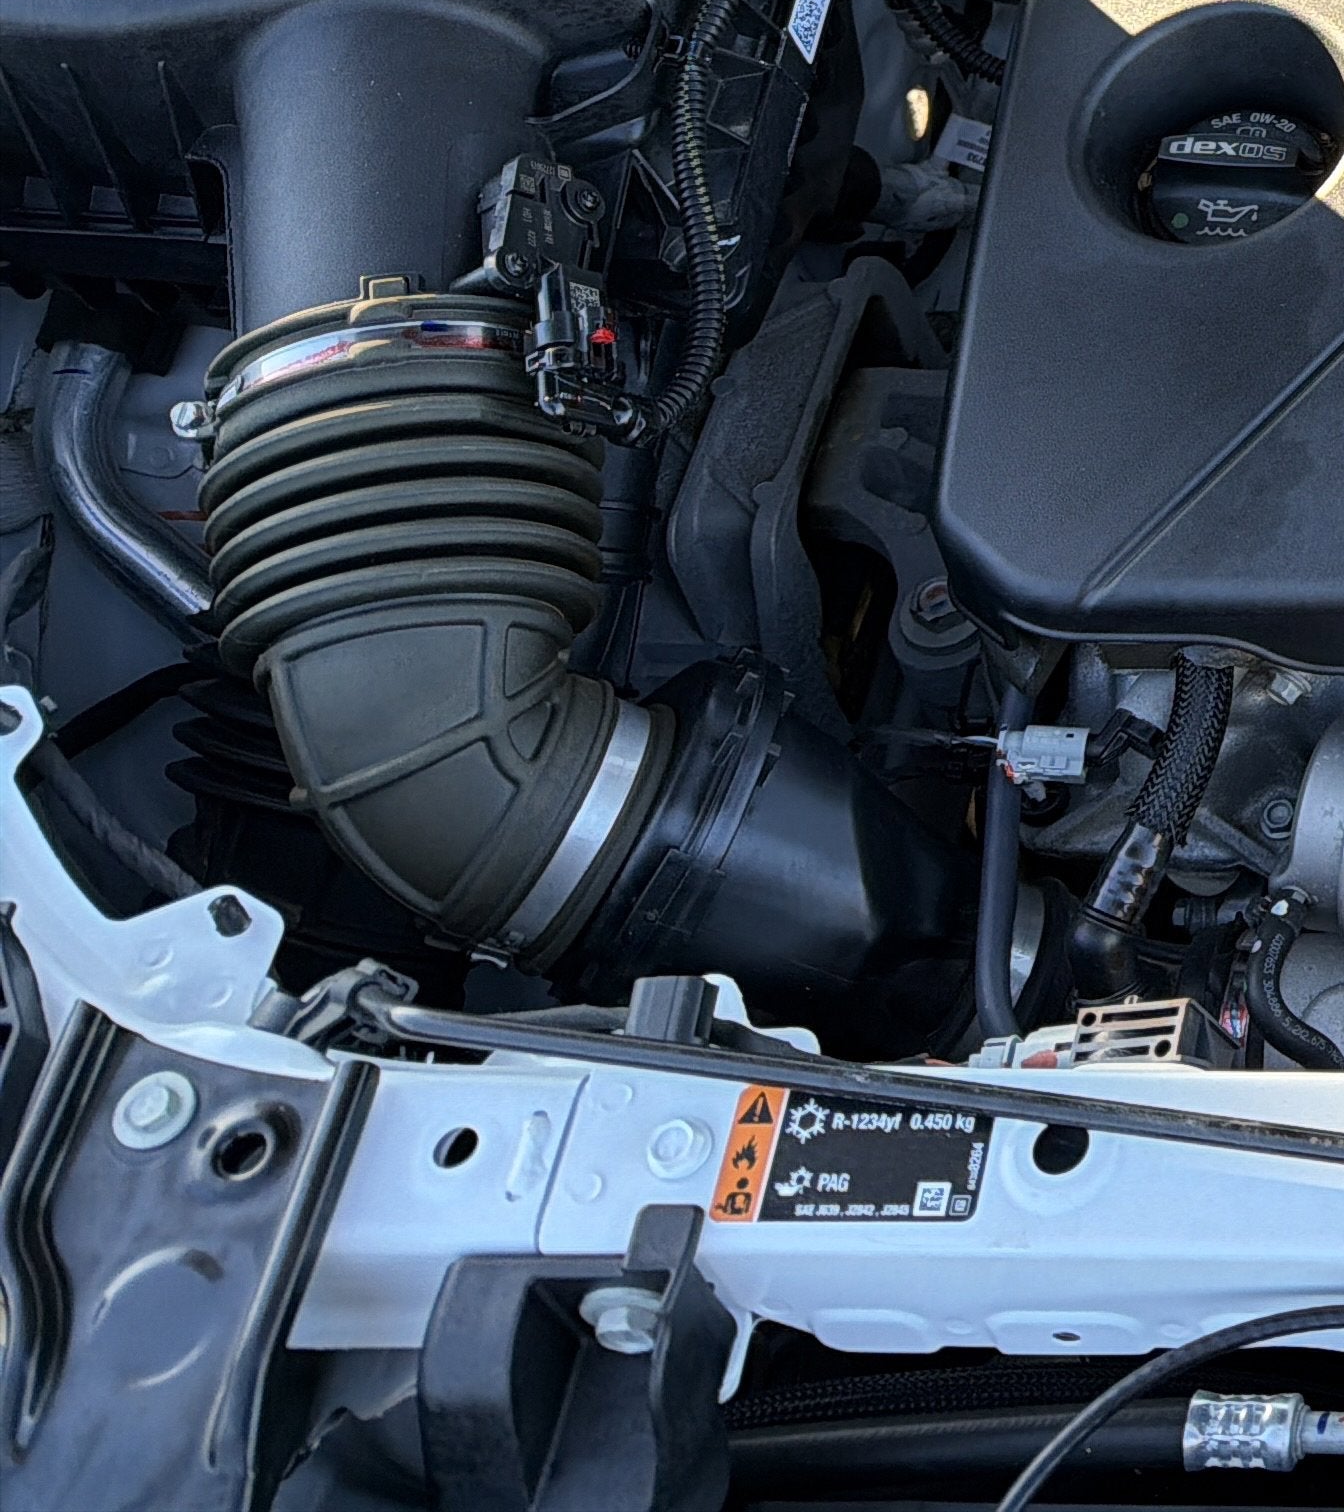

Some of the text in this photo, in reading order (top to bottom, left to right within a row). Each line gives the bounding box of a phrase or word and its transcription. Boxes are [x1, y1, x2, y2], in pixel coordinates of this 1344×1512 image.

[1210, 112, 1297, 133] SAE 0W-20
[1168, 136, 1288, 162] dexos
[831, 1112, 977, 1134] R-1234yf 0.450 kg
[816, 1173, 851, 1192] PAG
